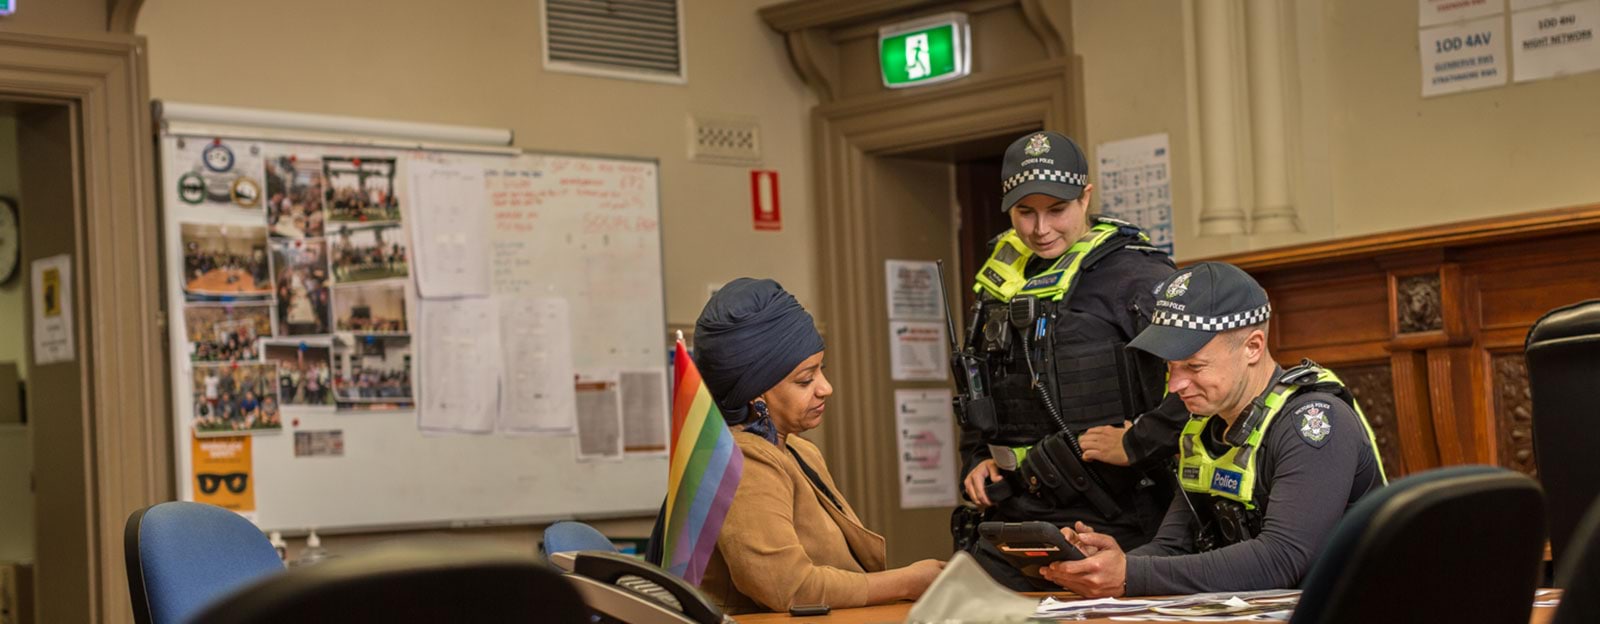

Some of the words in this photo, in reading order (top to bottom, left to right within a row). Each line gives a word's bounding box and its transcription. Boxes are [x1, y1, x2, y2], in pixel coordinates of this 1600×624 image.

[1465, 31, 1492, 48] 4AV
[1550, 28, 1592, 45] NETWORK
[1039, 157, 1054, 165] POLICE
[1169, 301, 1186, 311] POLICE
[1294, 403, 1314, 415] VICTORIA
[1315, 402, 1331, 410] POLICE
[1214, 472, 1239, 490] Police
